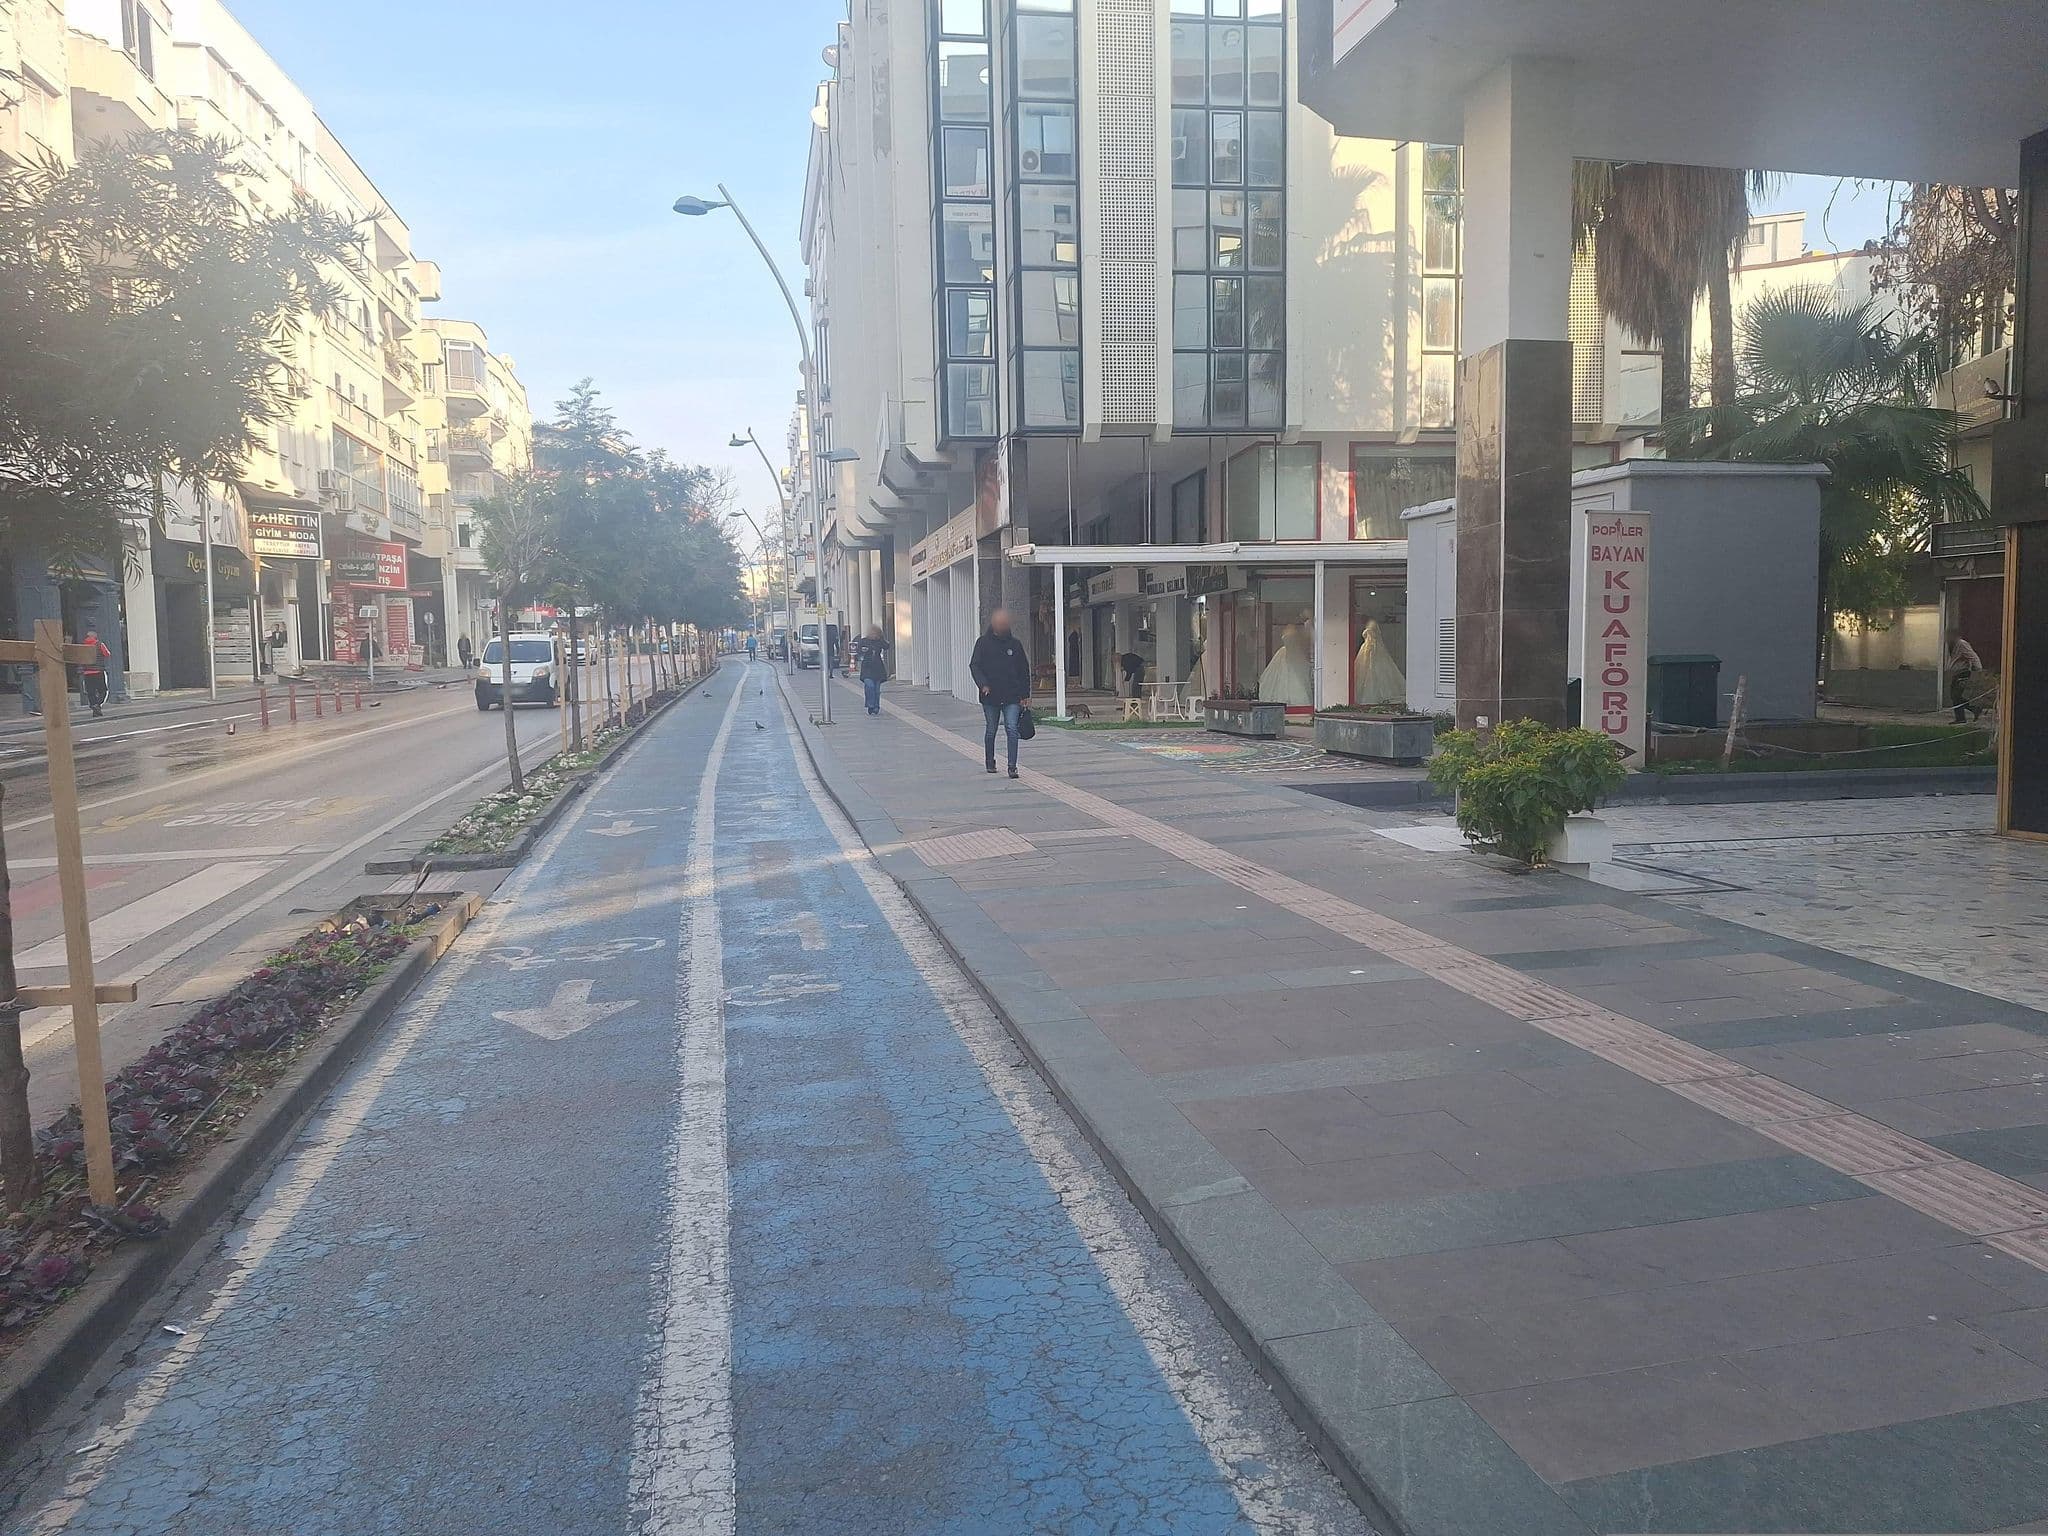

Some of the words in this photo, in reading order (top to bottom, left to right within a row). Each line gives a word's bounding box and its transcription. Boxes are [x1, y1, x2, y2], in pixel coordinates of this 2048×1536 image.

[252, 512, 318, 528] FAHRETTİN
[255, 528, 281, 538] GİYİM
[289, 531, 316, 540] MODA
[1591, 545, 1645, 562] BAYAN
[1601, 570, 1631, 735] KUAFÖRÜ
